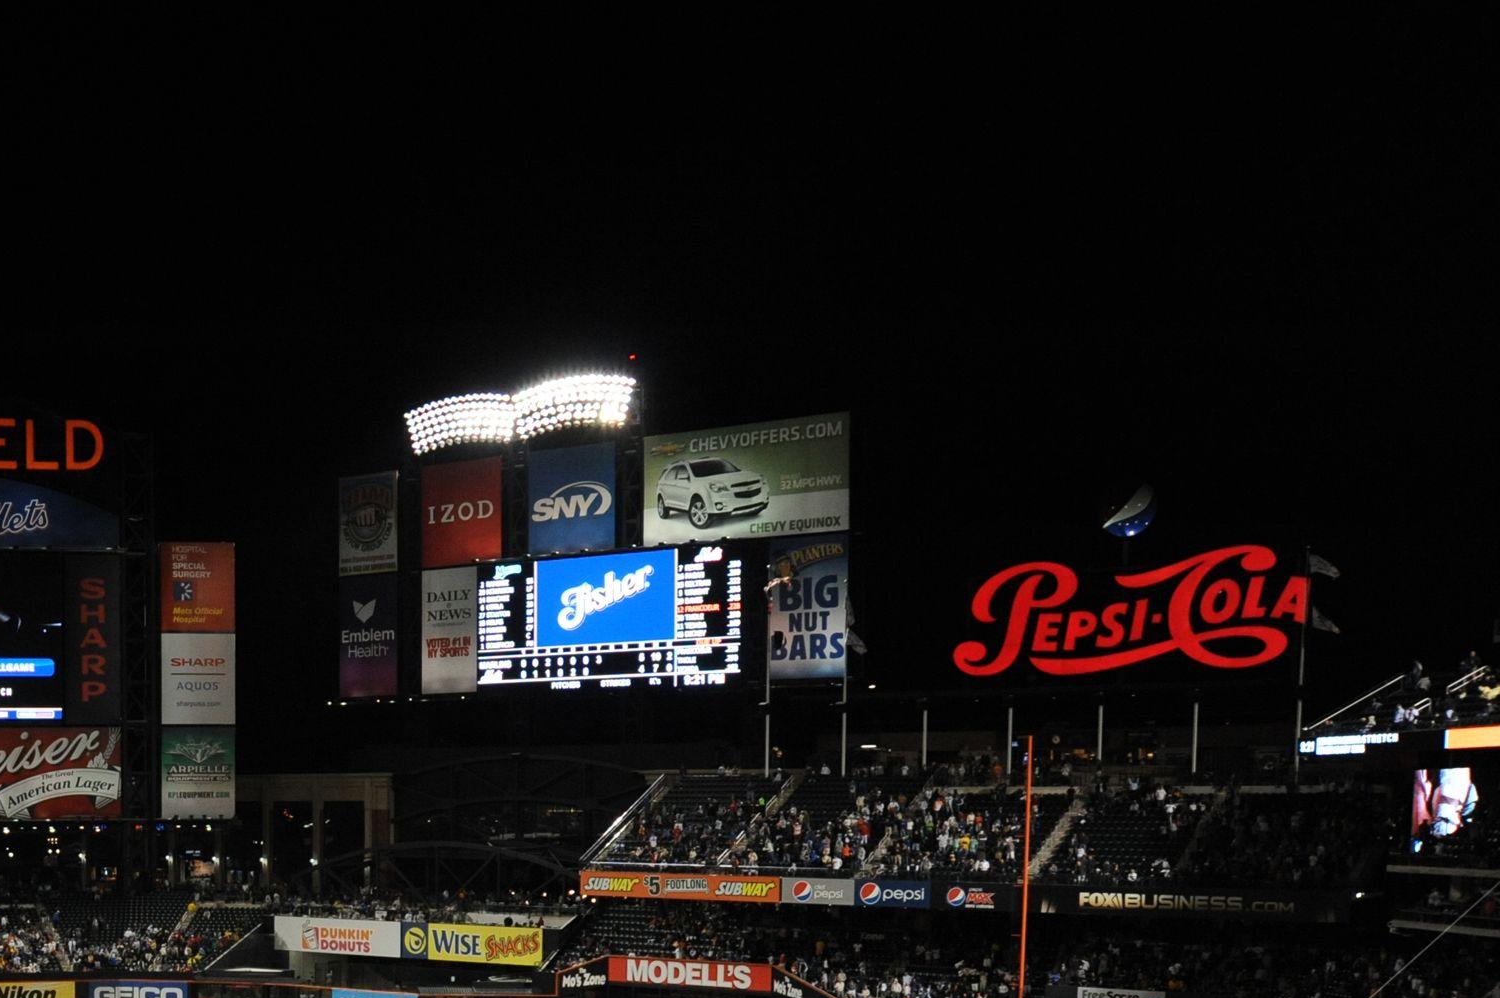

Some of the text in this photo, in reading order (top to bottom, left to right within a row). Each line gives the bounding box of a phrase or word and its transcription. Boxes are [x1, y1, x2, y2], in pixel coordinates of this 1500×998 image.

[689, 420, 843, 453] CHEVYOFFERS.COM
[427, 499, 494, 525] IZOD
[532, 492, 604, 522] SNY
[750, 516, 841, 534] CHEVY EQUINOX
[790, 543, 844, 564] PLANTERS
[172, 562, 206, 570] SPECIAL
[172, 570, 211, 578] SURGERY
[427, 589, 471, 603] DAILY
[557, 565, 656, 631] Fisher
[779, 574, 839, 612] BIG
[173, 616, 205, 624] Hospital
[427, 608, 471, 622] NEWS
[789, 611, 830, 632] NUT
[80, 577, 108, 703] SHARP
[341, 627, 395, 644] Emblem
[426, 637, 450, 649] VOTED
[348, 643, 388, 658] Health
[427, 647, 470, 659] NY SPORTS
[770, 632, 845, 661] BARS
[170, 658, 226, 667] SHARP
[176, 681, 219, 693] AQUOS
[56, 769, 74, 779] Great
[168, 765, 229, 774] ARPIELLE
[7, 775, 115, 810] American Lager
[584, 876, 778, 897] SUBWAY $5 FOOTLONG SUBWAY
[813, 889, 843, 900] pepsi
[882, 887, 925, 902] pepsi
[320, 927, 373, 941] DUNKIN'
[320, 939, 370, 952] DONUTS
[432, 930, 541, 961] WISE SNACKS
[562, 973, 606, 988] Mo's Zone
[626, 959, 752, 990] MODELL'S
[773, 979, 786, 994] Mo's
